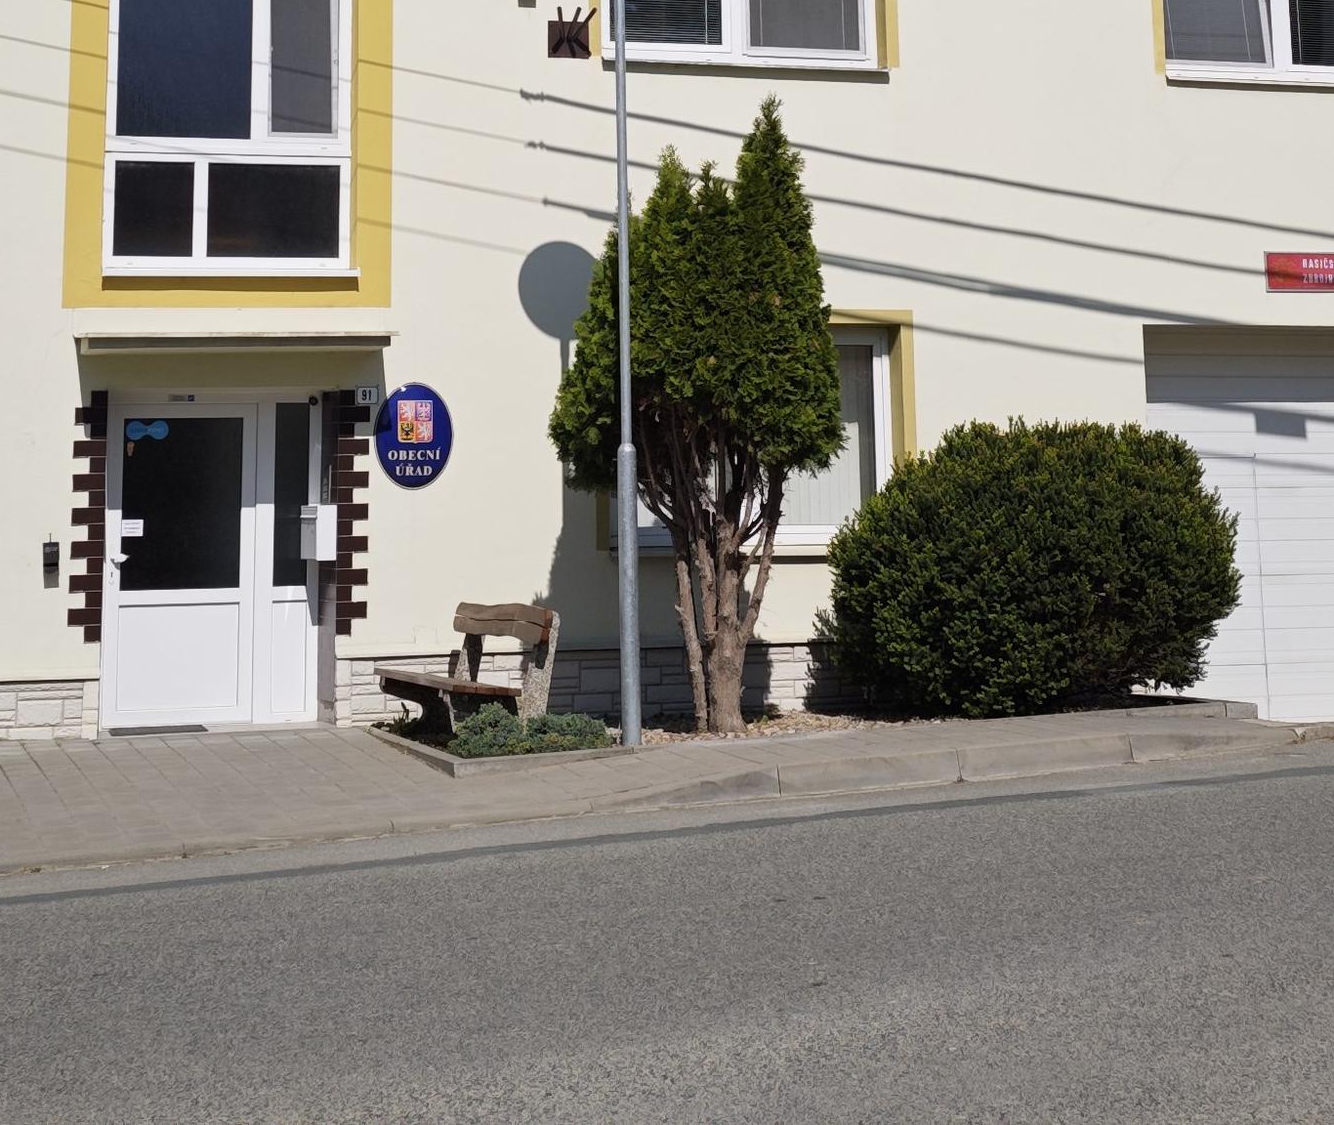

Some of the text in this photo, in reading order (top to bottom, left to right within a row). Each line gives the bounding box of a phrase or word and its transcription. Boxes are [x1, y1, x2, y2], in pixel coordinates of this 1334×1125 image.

[361, 389, 372, 401] 91
[387, 446, 442, 461] OBECNÍ
[395, 463, 433, 477] ÚŘAD
